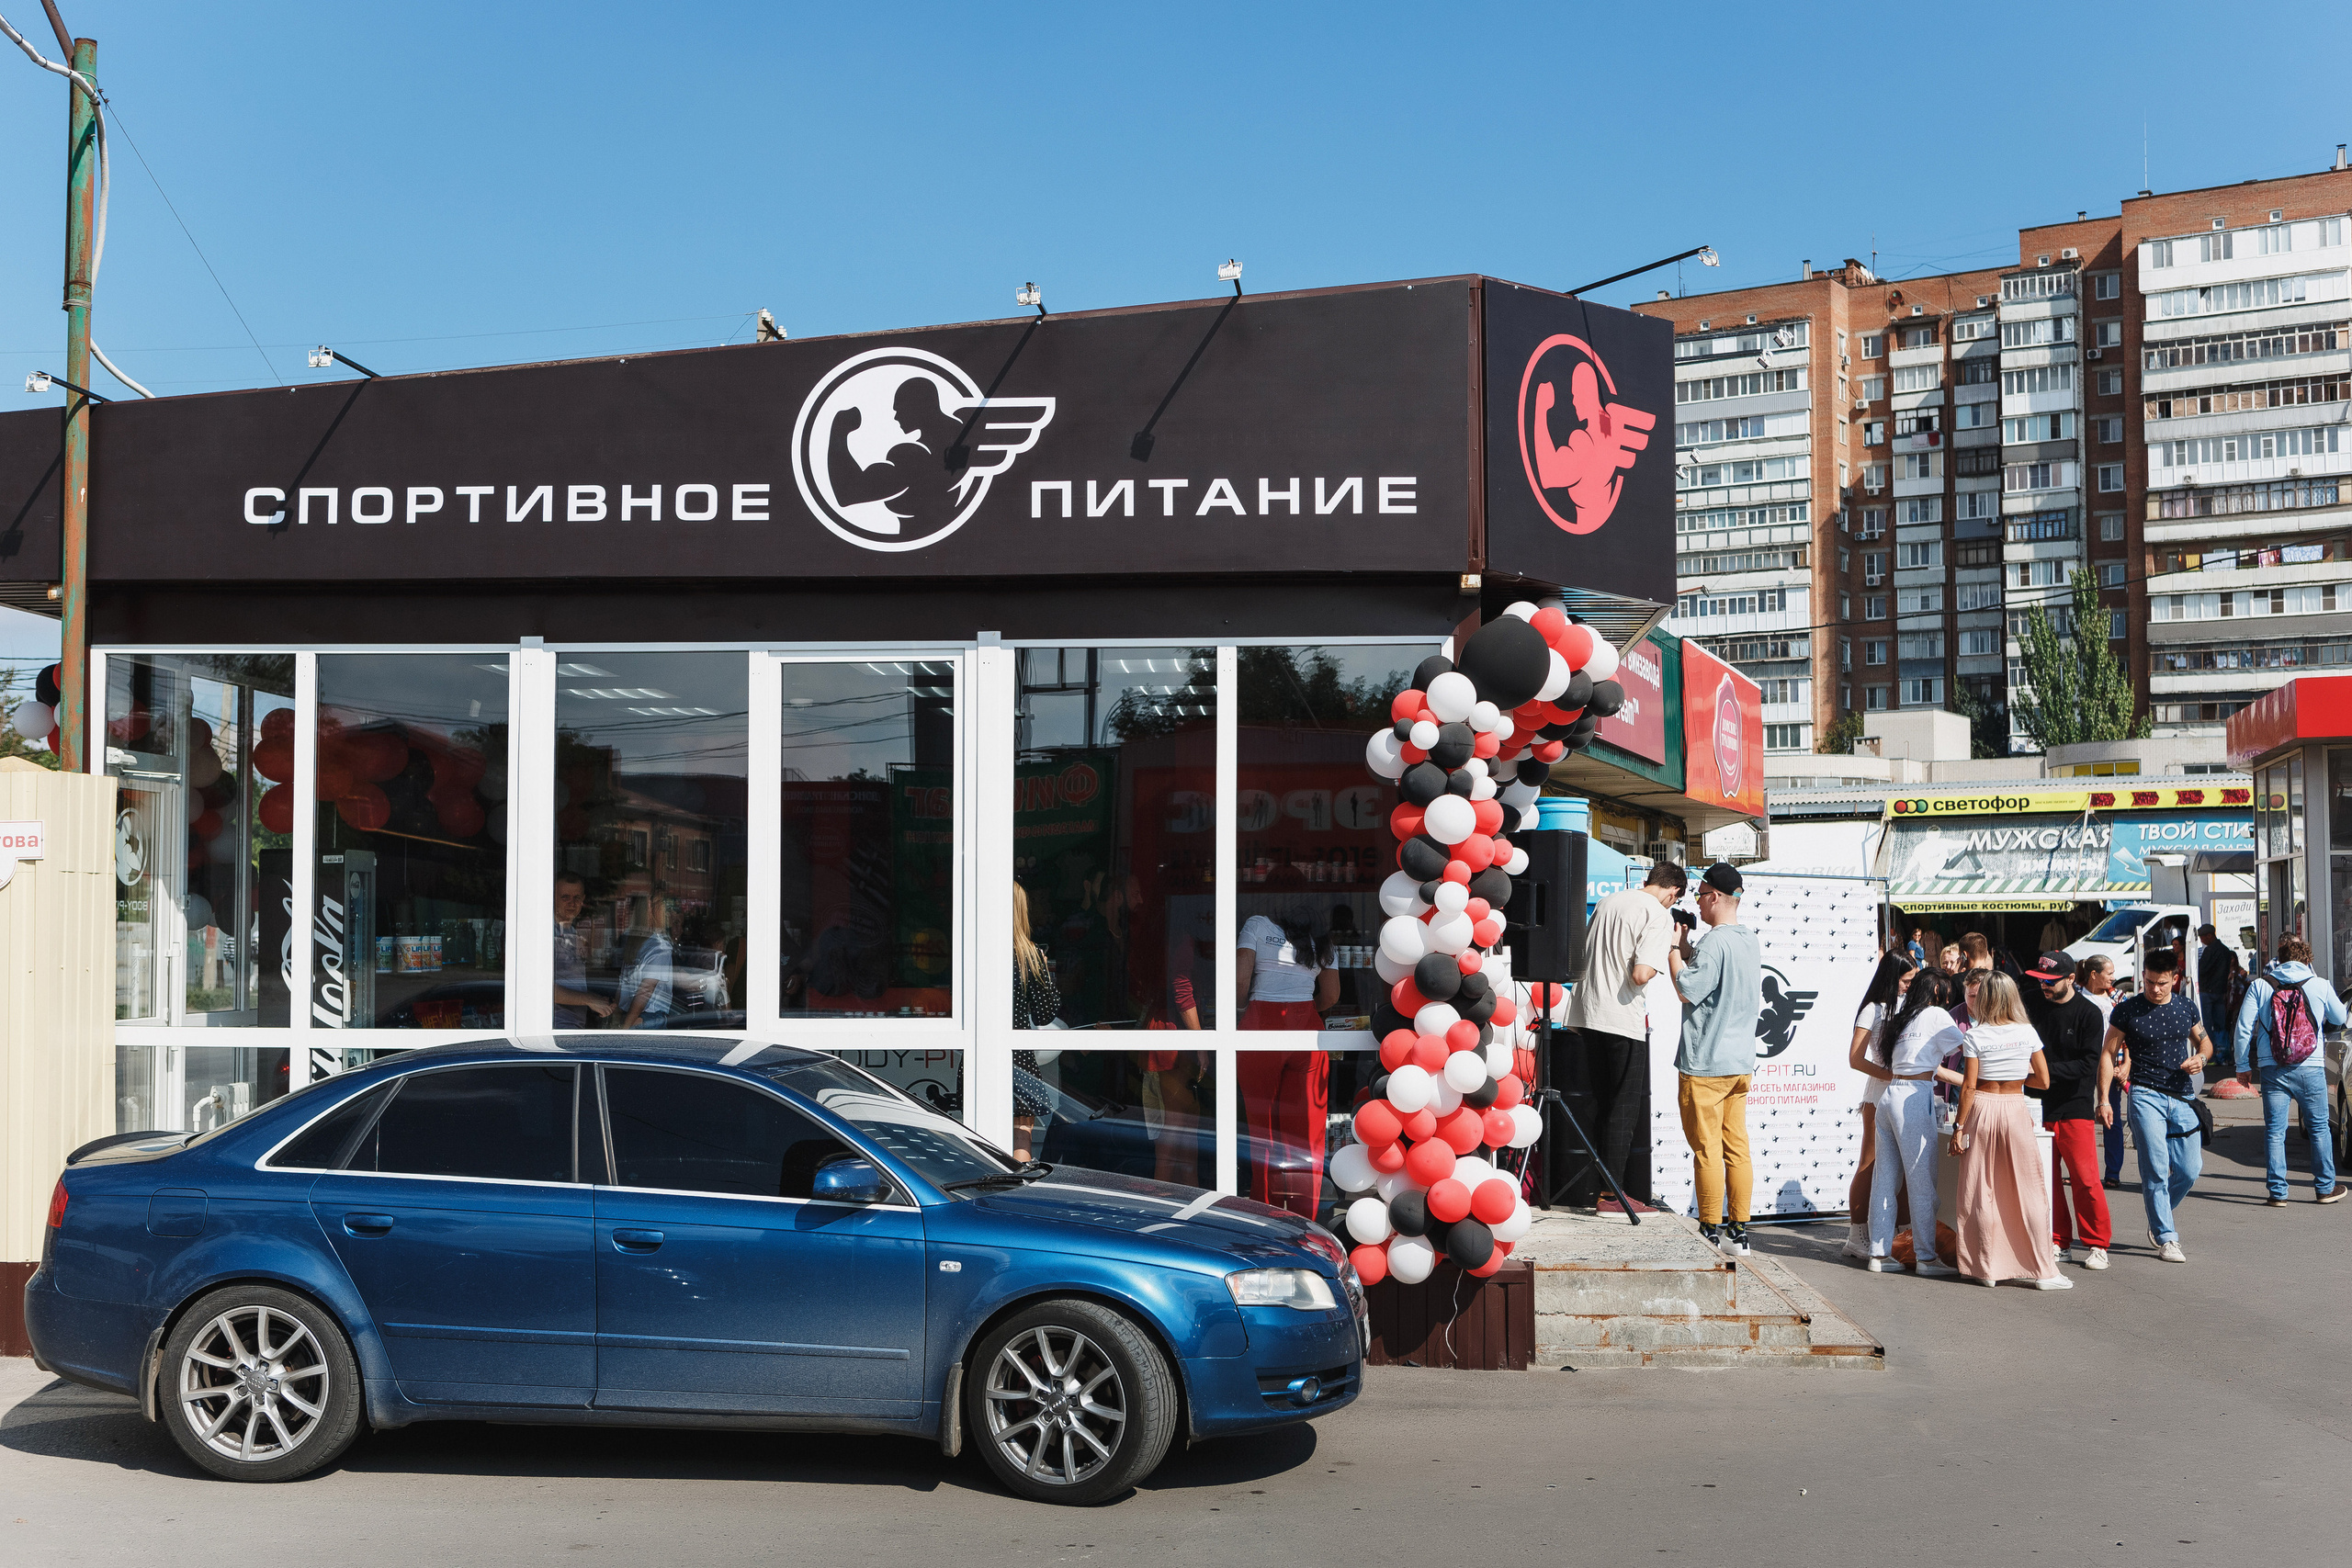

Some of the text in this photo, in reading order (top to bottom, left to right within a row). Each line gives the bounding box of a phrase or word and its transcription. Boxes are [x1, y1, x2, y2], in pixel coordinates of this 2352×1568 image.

[243, 477, 1417, 524] СПОРТИВНОЕ ПИТАНИЕ
[1933, 796, 2030, 812] светофор
[2138, 820, 2255, 840] ТВОЙ СТИ
[0, 835, 39, 848] ова
[1967, 827, 2111, 852] МУЖСКАЯ
[1903, 900, 2075, 913] спортивные костюмы, руб
[2217, 901, 2256, 915] Заходи!
[1753, 1065, 1816, 1077] Y-PIT.RU
[1760, 1084, 1781, 1092] СЕТЬ
[1783, 1083, 1837, 1092] МАГАЗИНОВ
[1777, 1096, 1818, 1104] ПИТАНИЯ
